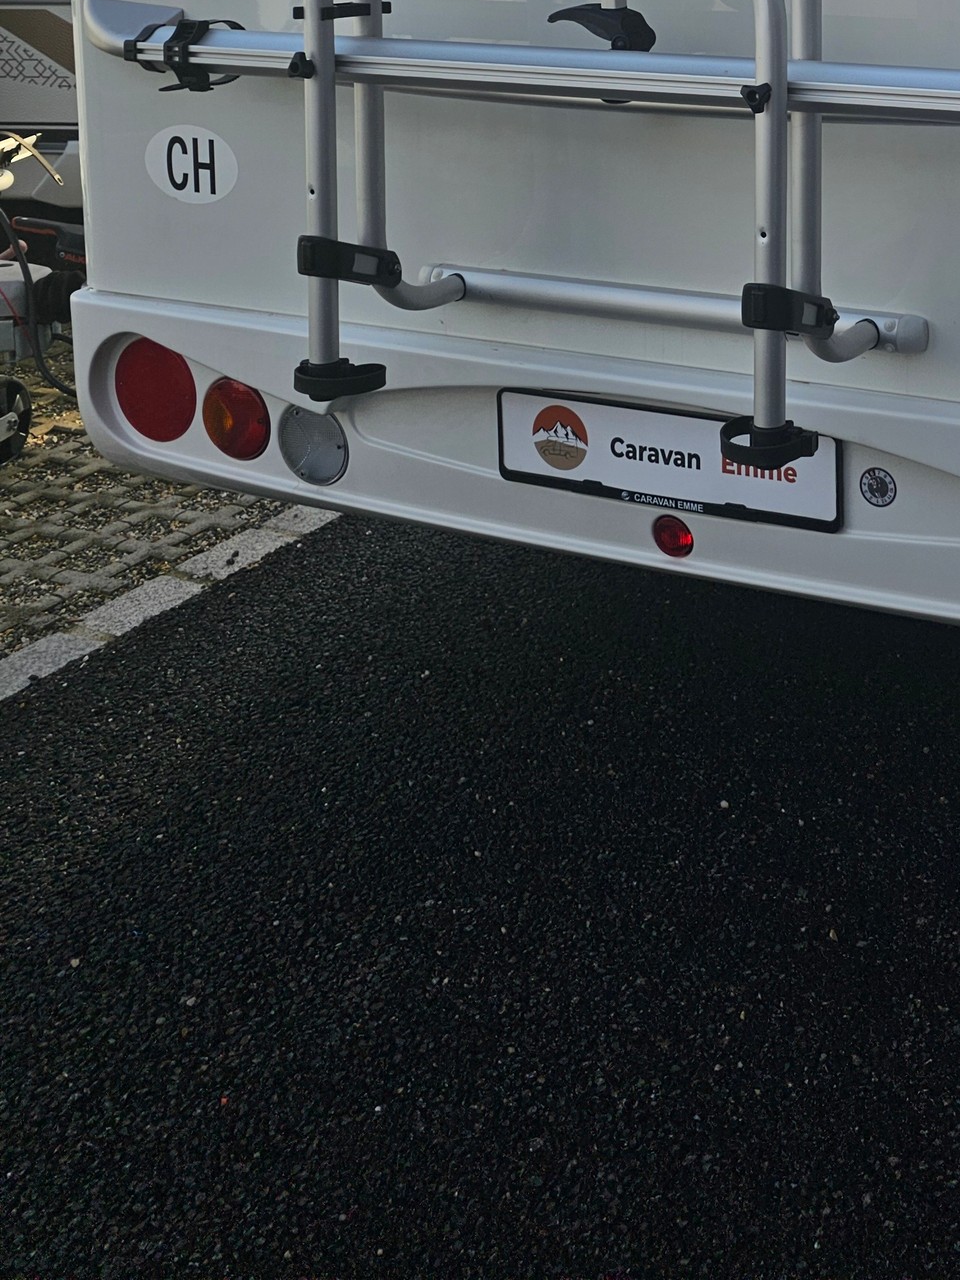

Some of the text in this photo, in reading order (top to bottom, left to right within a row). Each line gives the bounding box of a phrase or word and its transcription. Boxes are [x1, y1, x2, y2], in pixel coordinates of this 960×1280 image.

[166, 135, 216, 195] CH
[610, 436, 702, 470] Caravan
[634, 493, 704, 513] CARAVAN EMME
